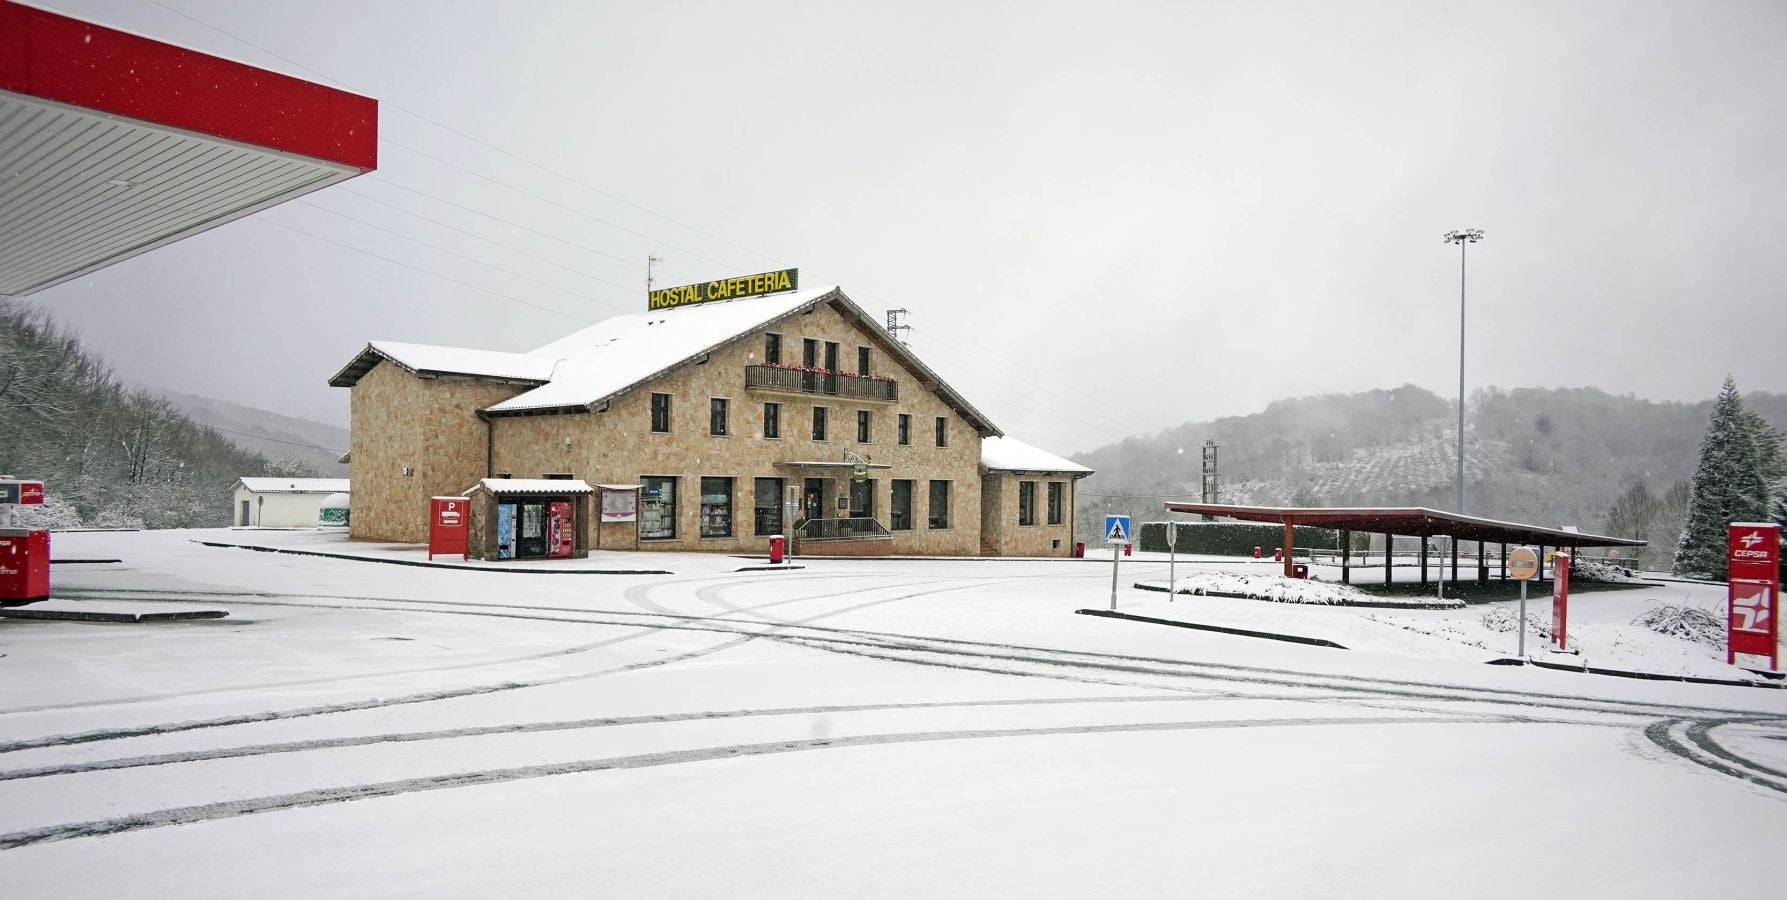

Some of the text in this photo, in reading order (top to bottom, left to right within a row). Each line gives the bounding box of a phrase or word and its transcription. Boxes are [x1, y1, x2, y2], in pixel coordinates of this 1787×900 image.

[651, 271, 791, 308] HOSTAL CAFETERIA
[448, 502, 456, 511] P
[1734, 549, 1768, 558] CEPSA
